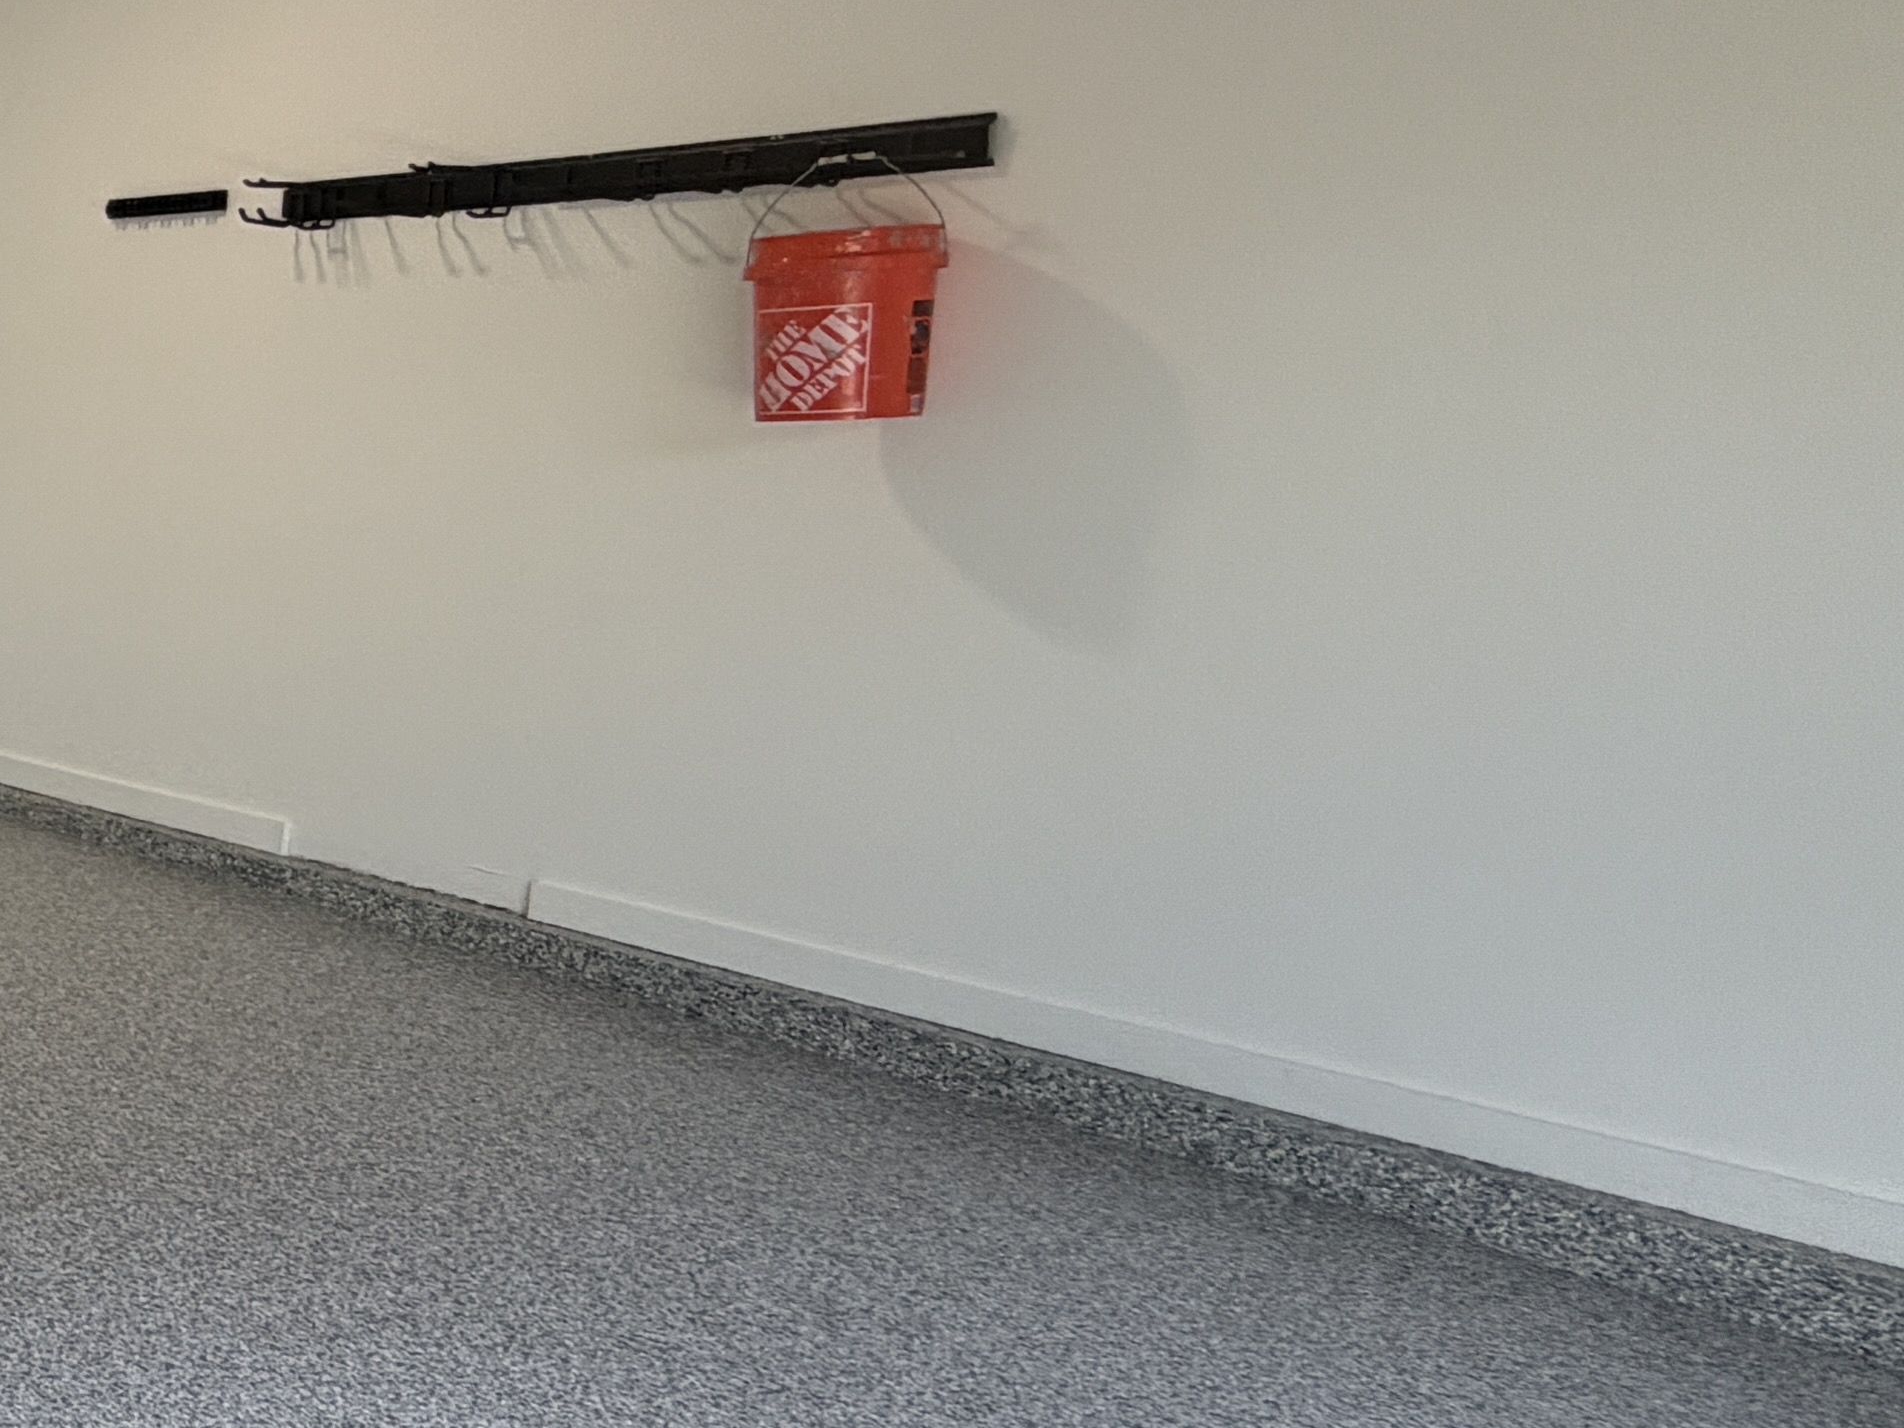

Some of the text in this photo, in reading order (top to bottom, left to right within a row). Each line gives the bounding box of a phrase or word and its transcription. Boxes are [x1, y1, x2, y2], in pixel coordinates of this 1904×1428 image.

[759, 306, 868, 412] HOME
[765, 319, 807, 362] THE
[790, 344, 866, 412] DEPOT
